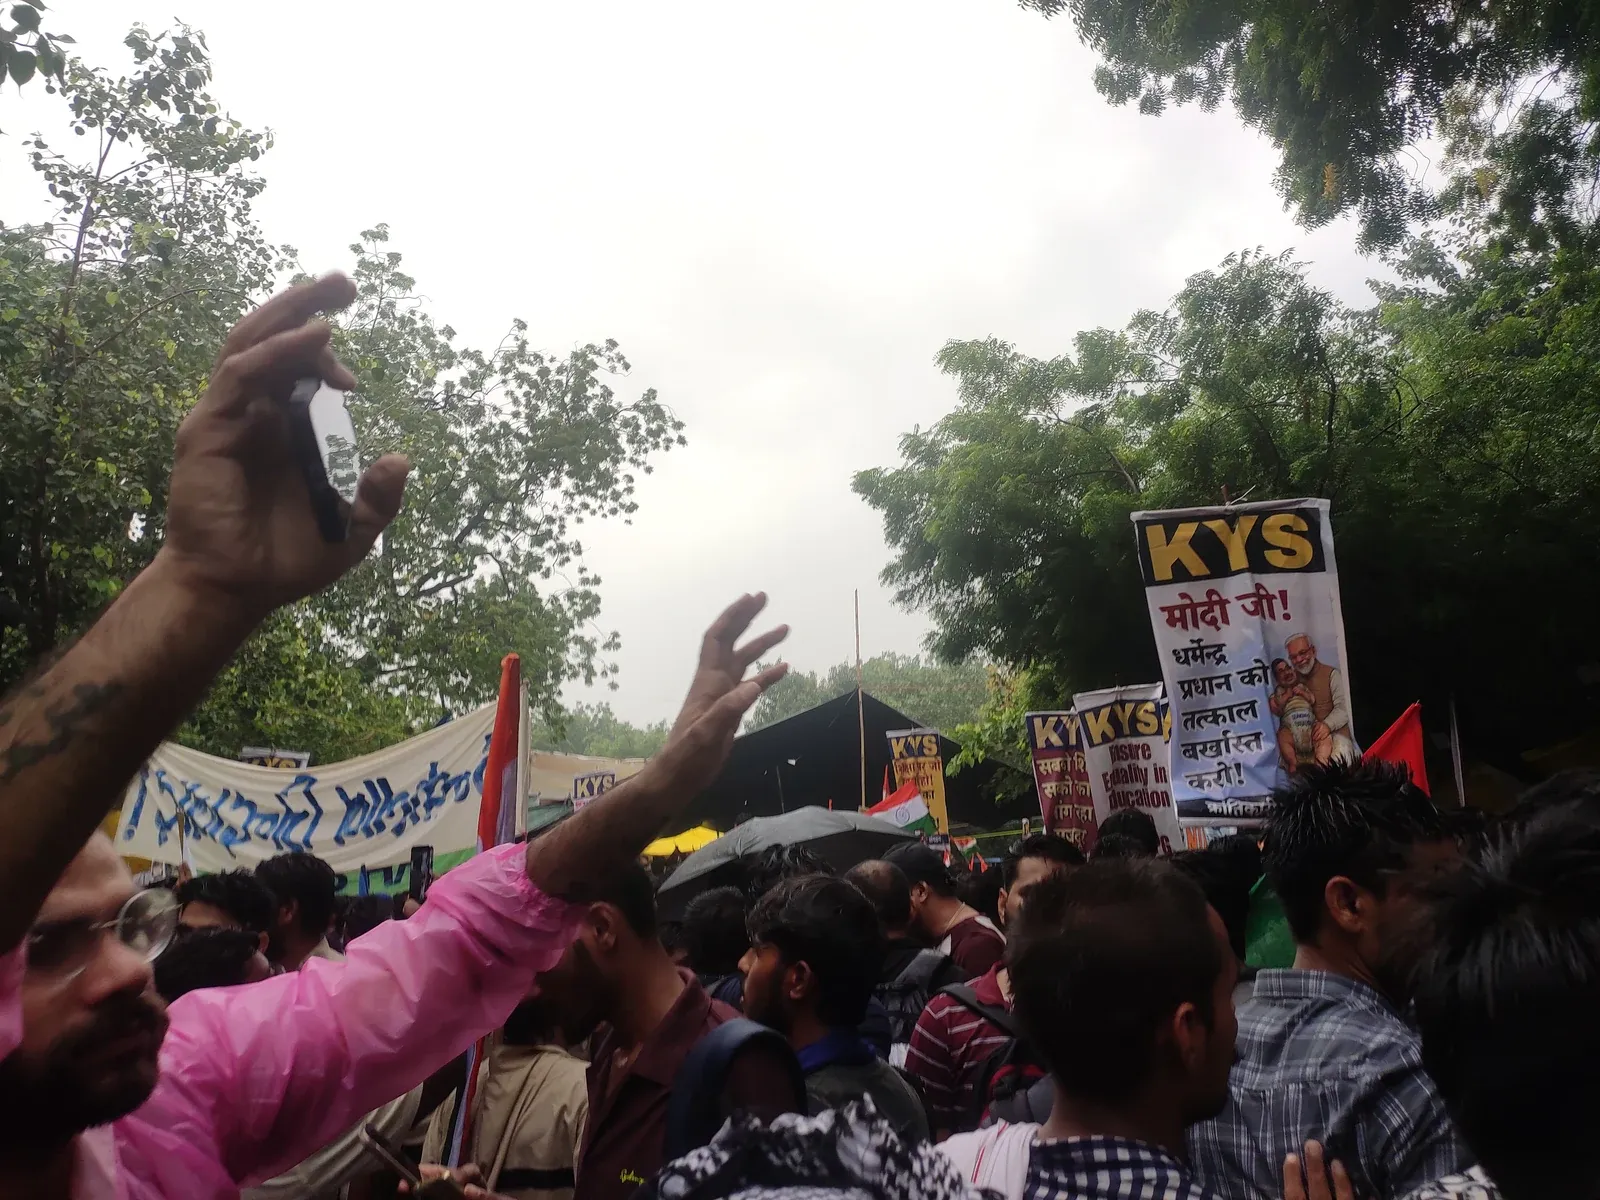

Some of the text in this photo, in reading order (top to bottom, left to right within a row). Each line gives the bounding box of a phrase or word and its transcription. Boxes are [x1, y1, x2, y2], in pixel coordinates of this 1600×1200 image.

[1145, 513, 1313, 581] KYS
[1159, 582, 1292, 631] मोदी जी!
[1172, 638, 1228, 667] धर्मेन्द्र
[1177, 658, 1270, 700] प्रधान को
[1085, 700, 1158, 744] KYS
[1181, 699, 1258, 731] तत्काल
[891, 735, 938, 760] KYS
[1033, 716, 1080, 749] KY
[1180, 729, 1263, 760] बर्खास्त
[577, 776, 614, 799] KYS
[1153, 762, 1168, 784] in
[1184, 761, 1245, 790] करो!
